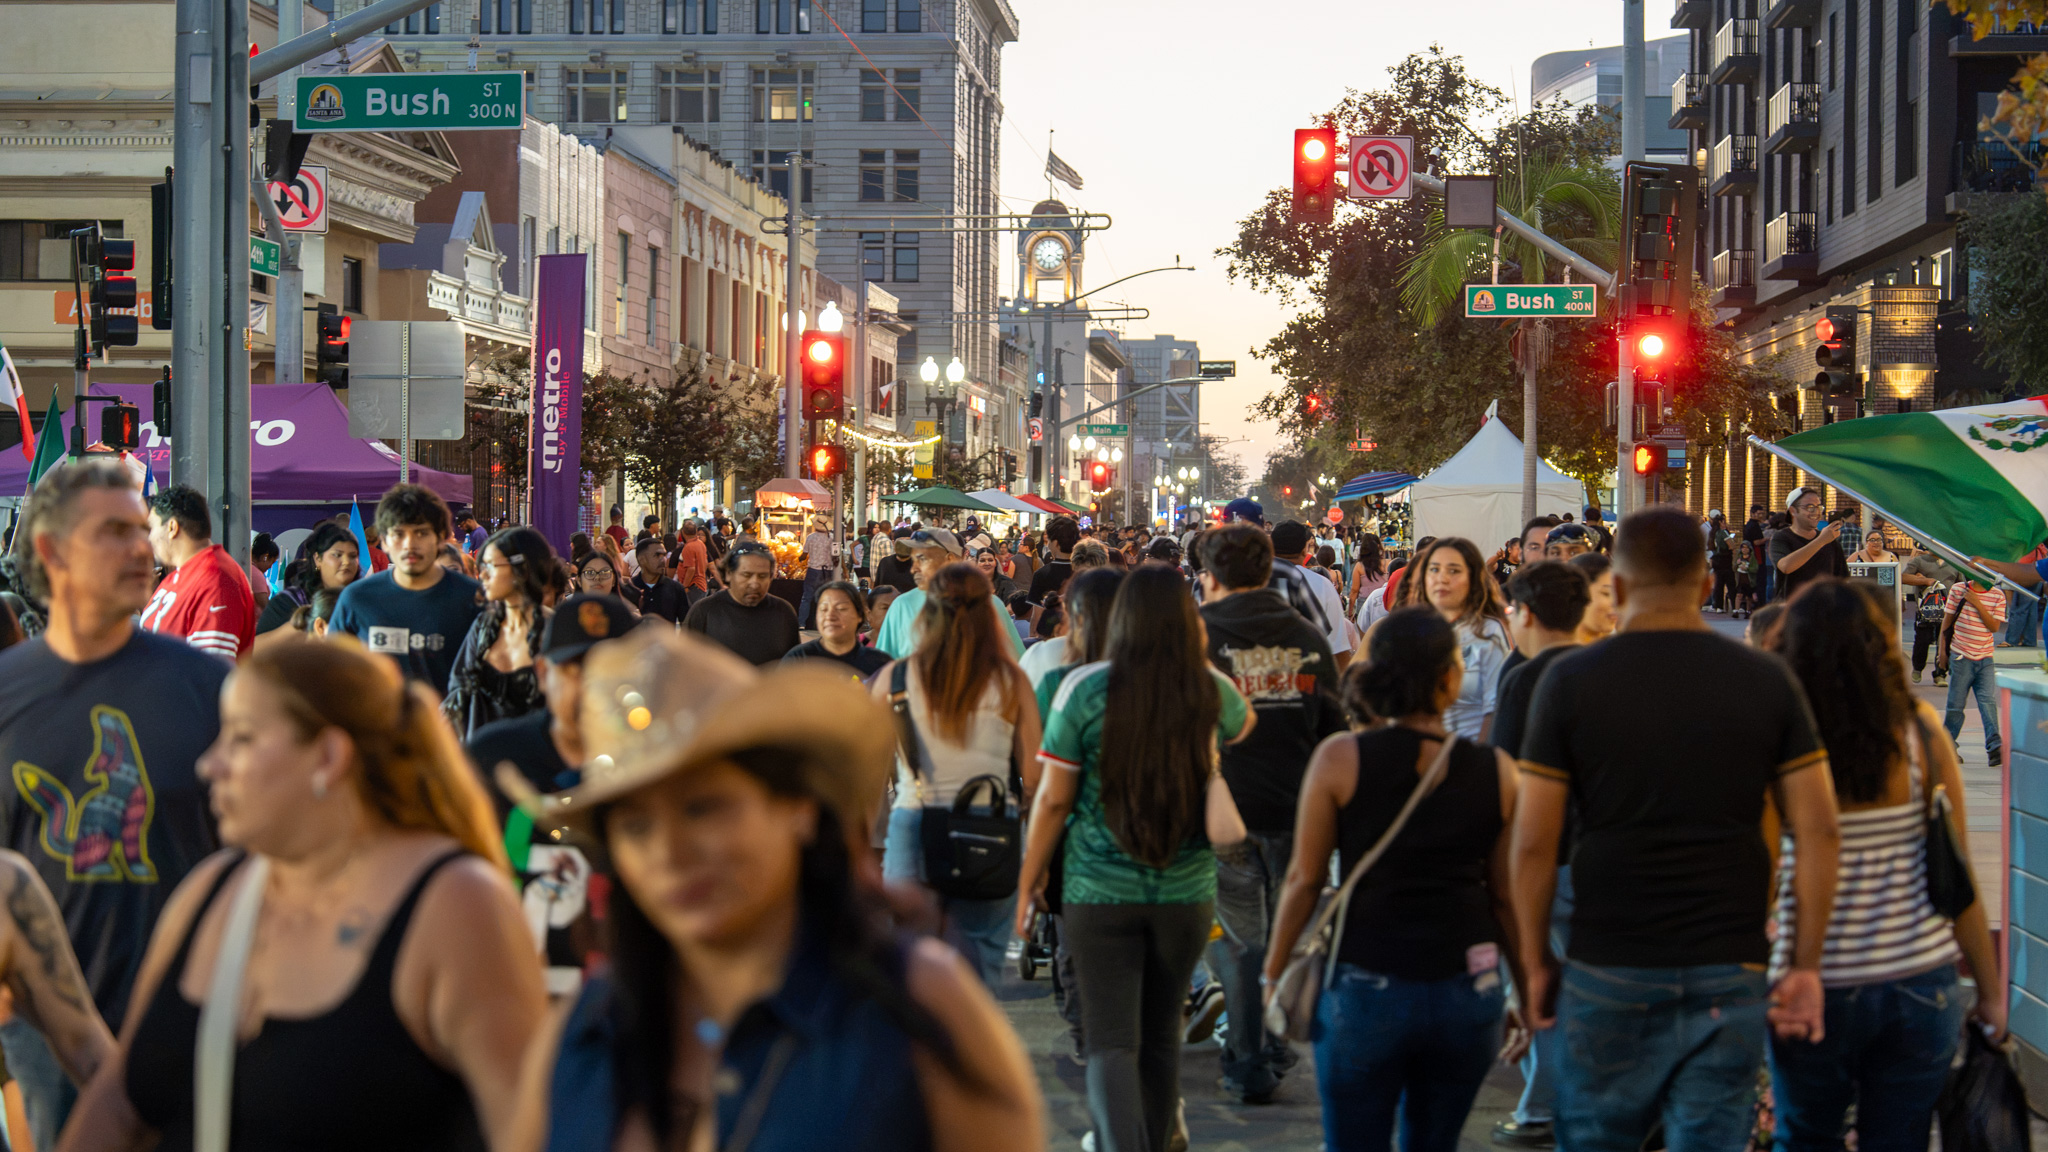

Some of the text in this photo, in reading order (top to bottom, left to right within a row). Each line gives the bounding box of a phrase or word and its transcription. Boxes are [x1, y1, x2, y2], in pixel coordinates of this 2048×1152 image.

[483, 83, 502, 97] ST
[366, 88, 450, 116] Bush
[309, 109, 328, 117] SANTA
[251, 245, 264, 265] 4th
[1506, 293, 1555, 309] Bush
[1572, 291, 1584, 299] ST
[543, 348, 562, 473] metro
[1092, 426, 1112, 434] Main
